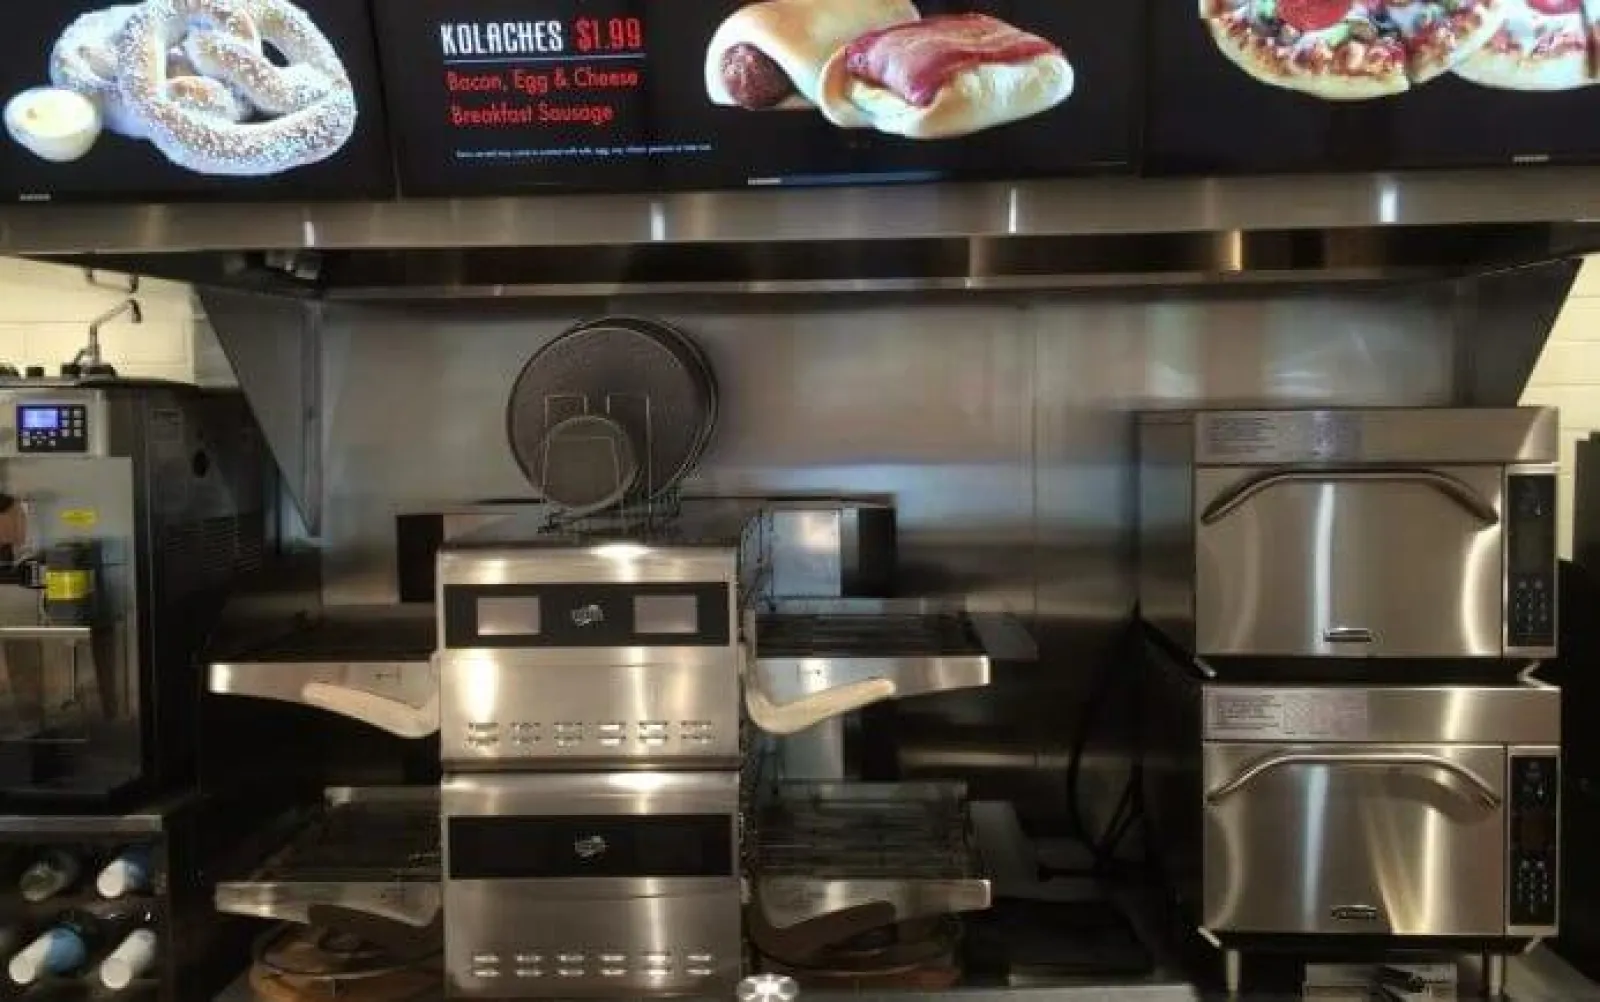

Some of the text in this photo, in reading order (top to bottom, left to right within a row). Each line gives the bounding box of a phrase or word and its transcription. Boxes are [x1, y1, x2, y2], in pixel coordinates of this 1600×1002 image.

[440, 17, 643, 55] KOLACHES $1.99
[447, 66, 638, 94] Bacon, Egg & Cheese
[451, 102, 614, 125] Breakfast Sausage
